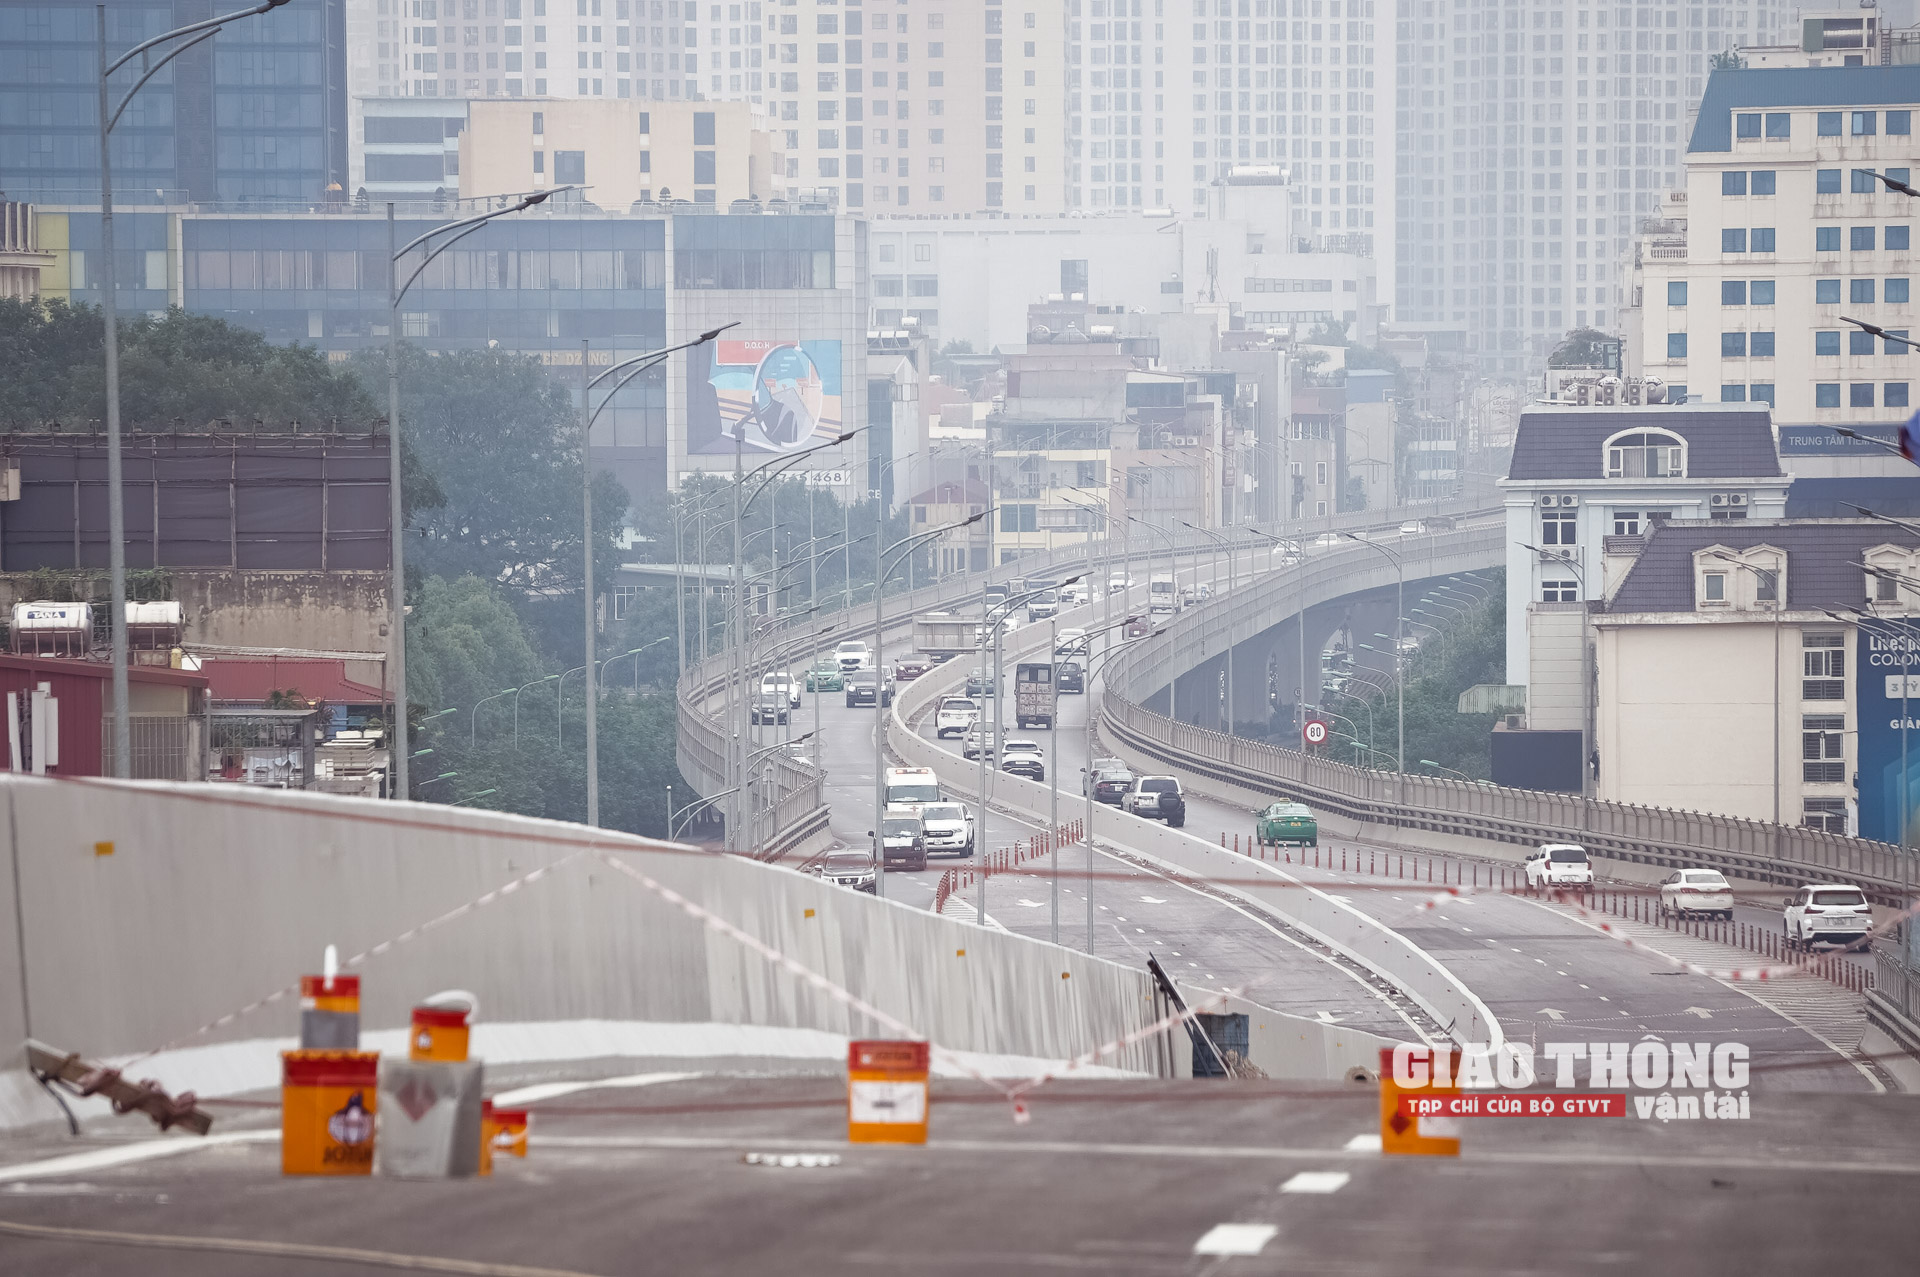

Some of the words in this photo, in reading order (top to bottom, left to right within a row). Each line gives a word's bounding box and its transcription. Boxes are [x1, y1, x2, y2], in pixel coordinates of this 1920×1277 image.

[1788, 436, 1821, 446] TRUNG
[1825, 434, 1845, 446] TÂM
[1310, 726, 1321, 738] 80
